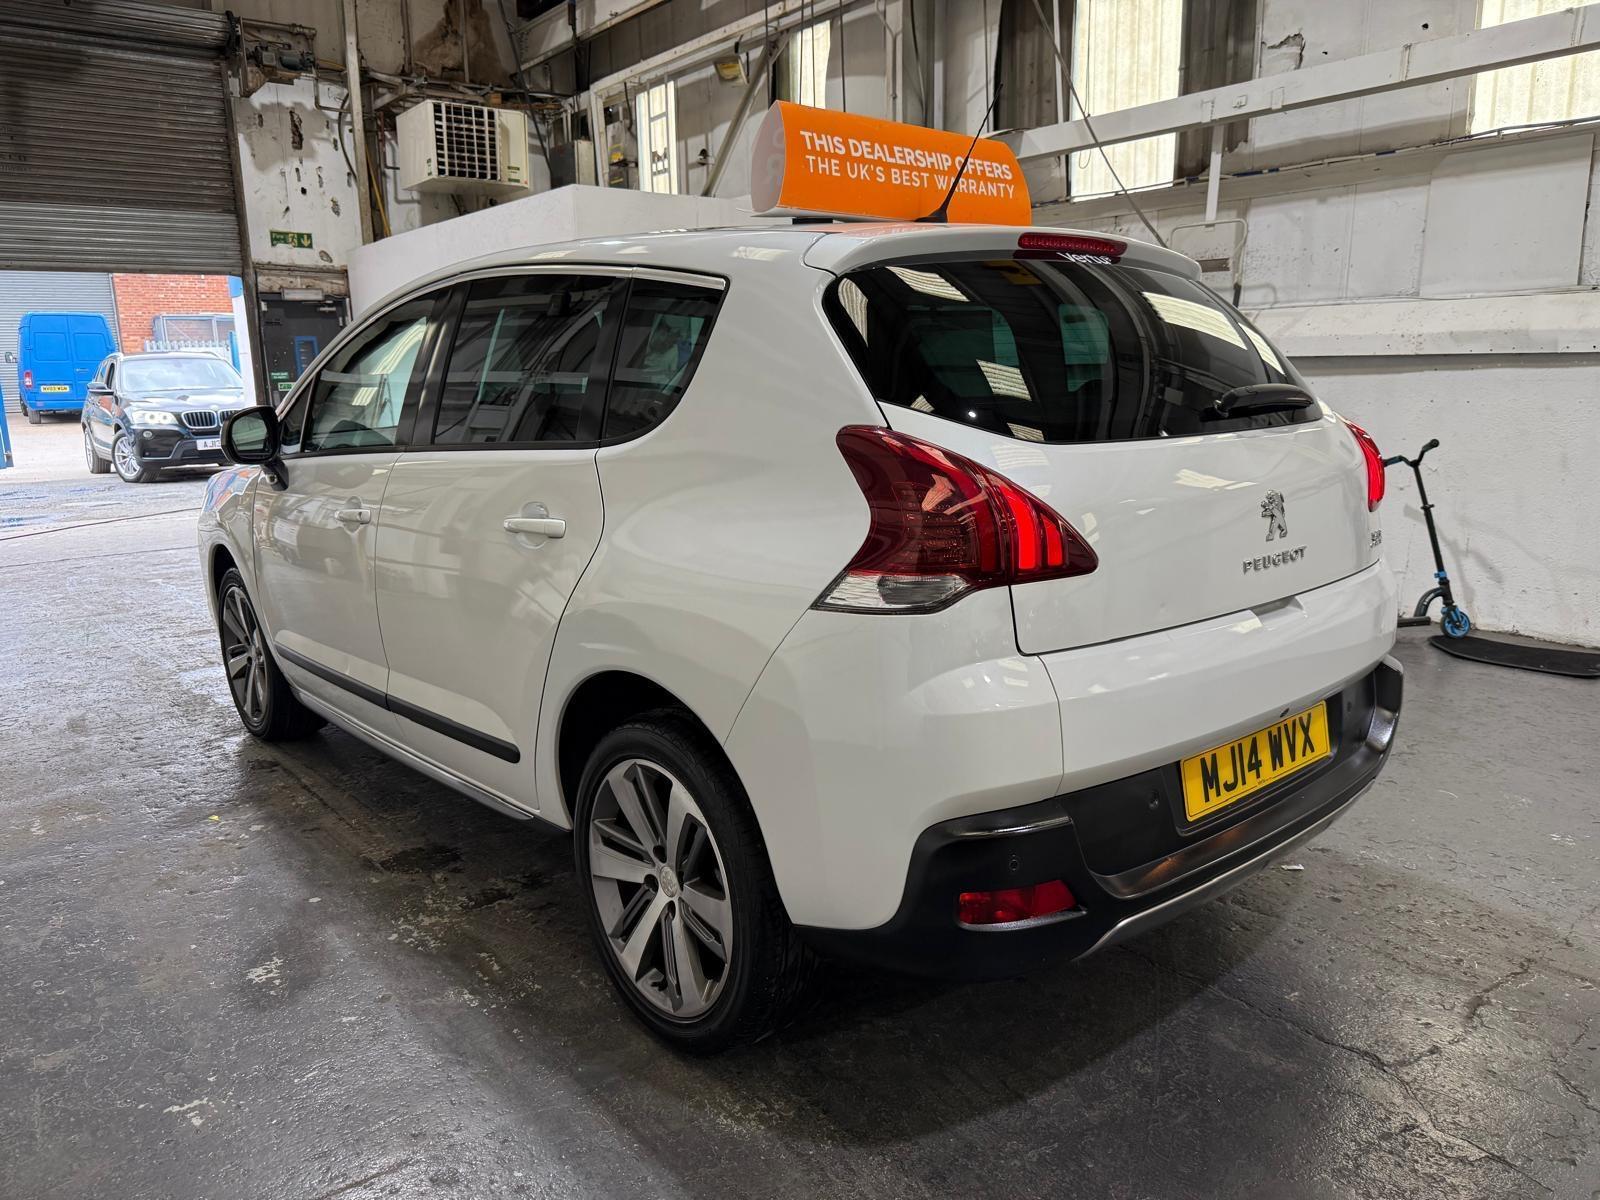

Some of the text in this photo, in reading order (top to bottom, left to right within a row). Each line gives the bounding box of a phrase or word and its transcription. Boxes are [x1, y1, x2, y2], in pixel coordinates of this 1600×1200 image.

[800, 130, 1013, 180] THIS DEALERSHIP OFFERS
[805, 155, 841, 177] THE
[846, 162, 886, 183] UK'S
[891, 168, 930, 188] BEST
[1242, 545, 1307, 575] PEUGEOT
[1199, 711, 1315, 803] MJ14 WVX
